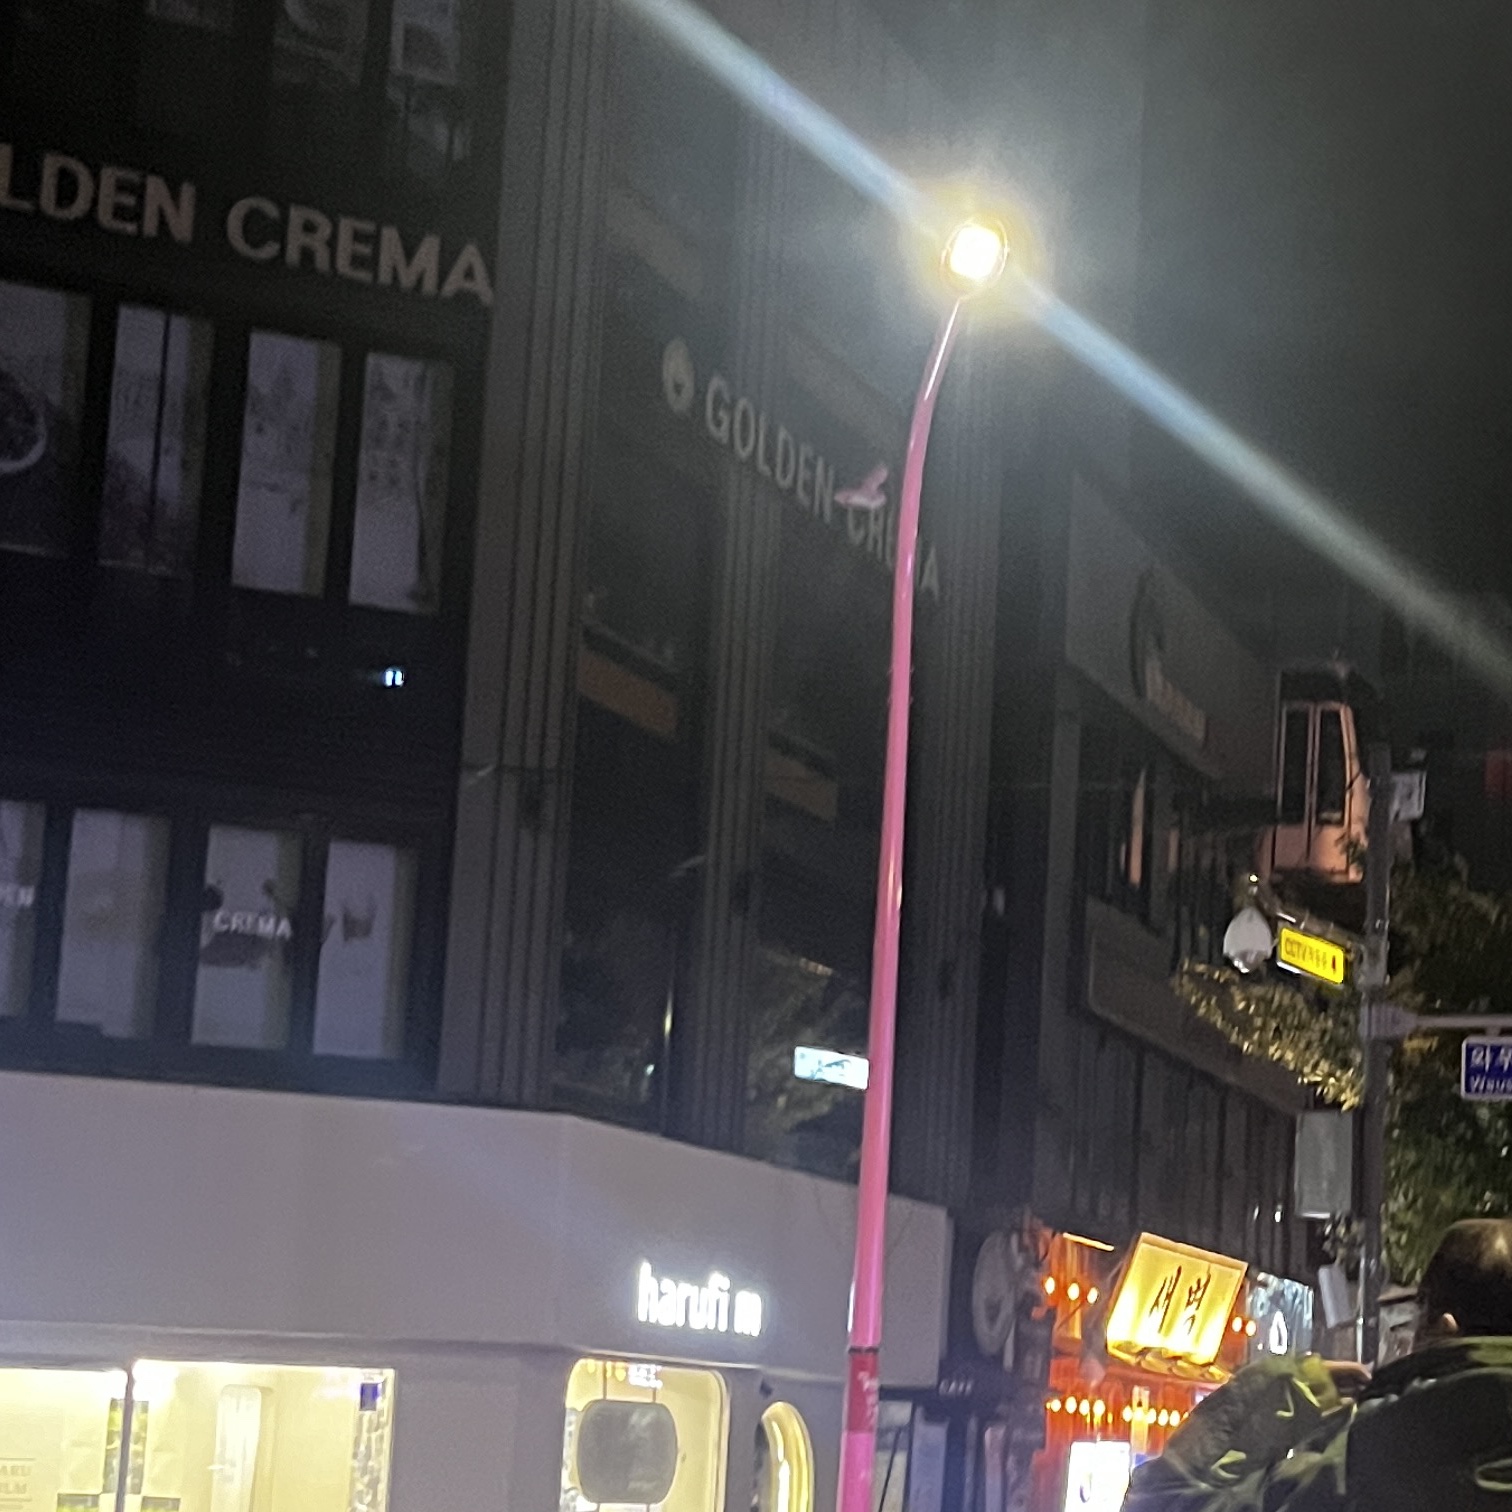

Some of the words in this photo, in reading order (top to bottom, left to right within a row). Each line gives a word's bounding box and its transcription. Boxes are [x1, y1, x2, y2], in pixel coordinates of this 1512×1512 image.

[226, 195, 495, 307] CREMA
[704, 375, 835, 525] GOLDEN
[213, 910, 292, 938] CREMA
